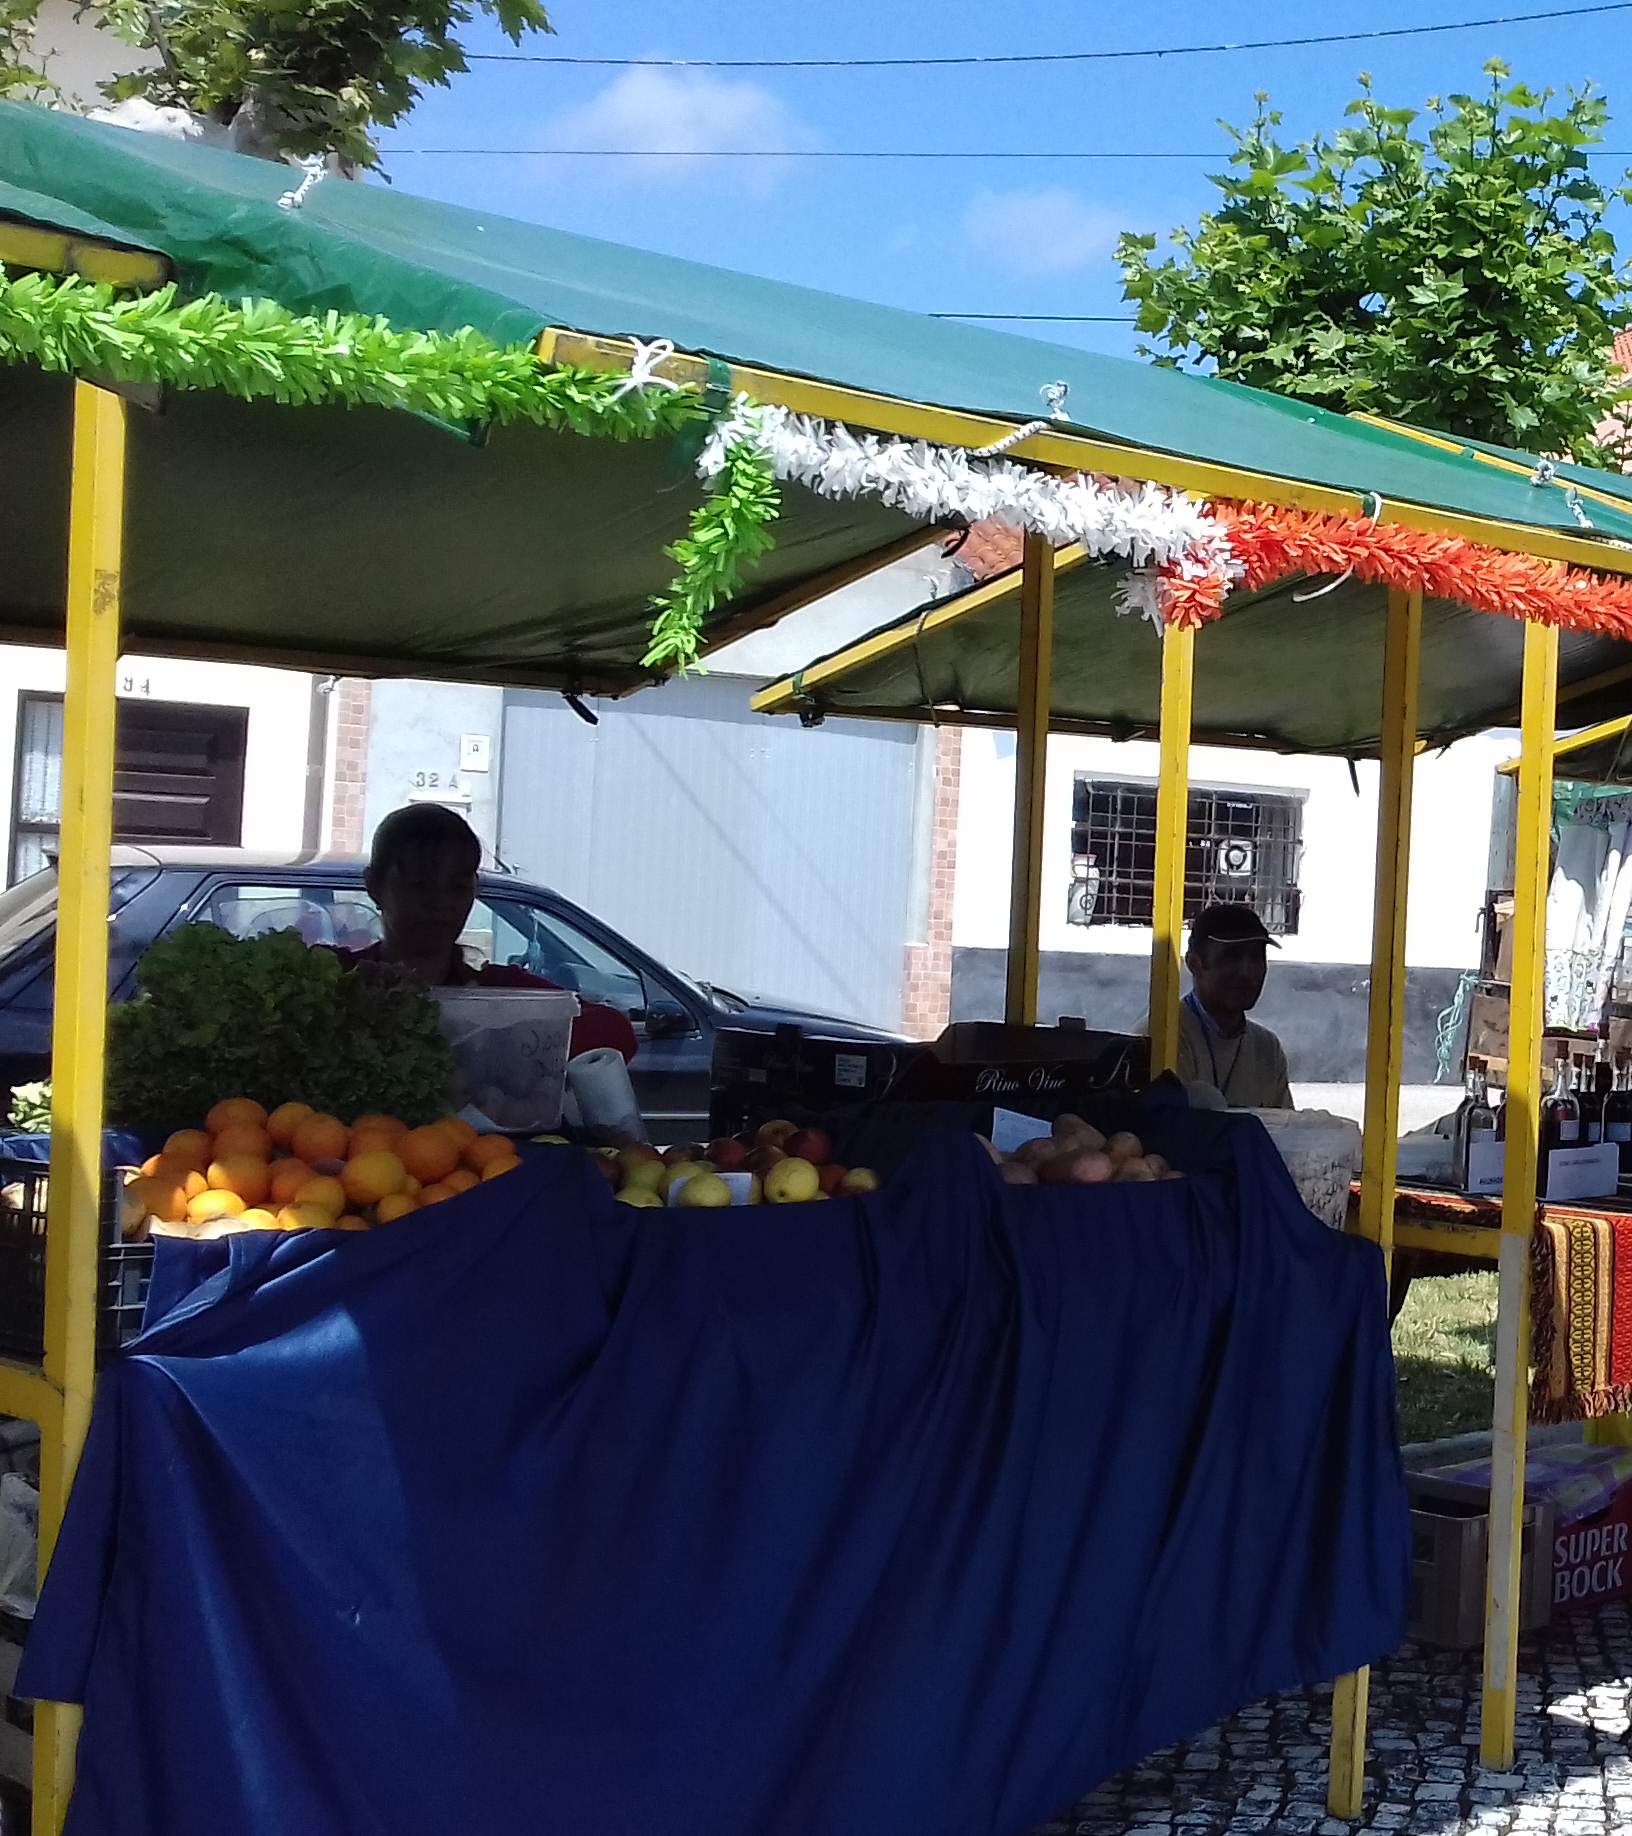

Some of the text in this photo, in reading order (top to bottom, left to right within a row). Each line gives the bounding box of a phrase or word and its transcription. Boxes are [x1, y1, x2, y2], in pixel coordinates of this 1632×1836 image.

[416, 771, 439, 788] 32
[975, 1068, 1019, 1092] Rino
[1028, 1064, 1065, 1091] Vine
[1553, 1522, 1629, 1568] SUPER
[1554, 1557, 1623, 1603] BOCK
